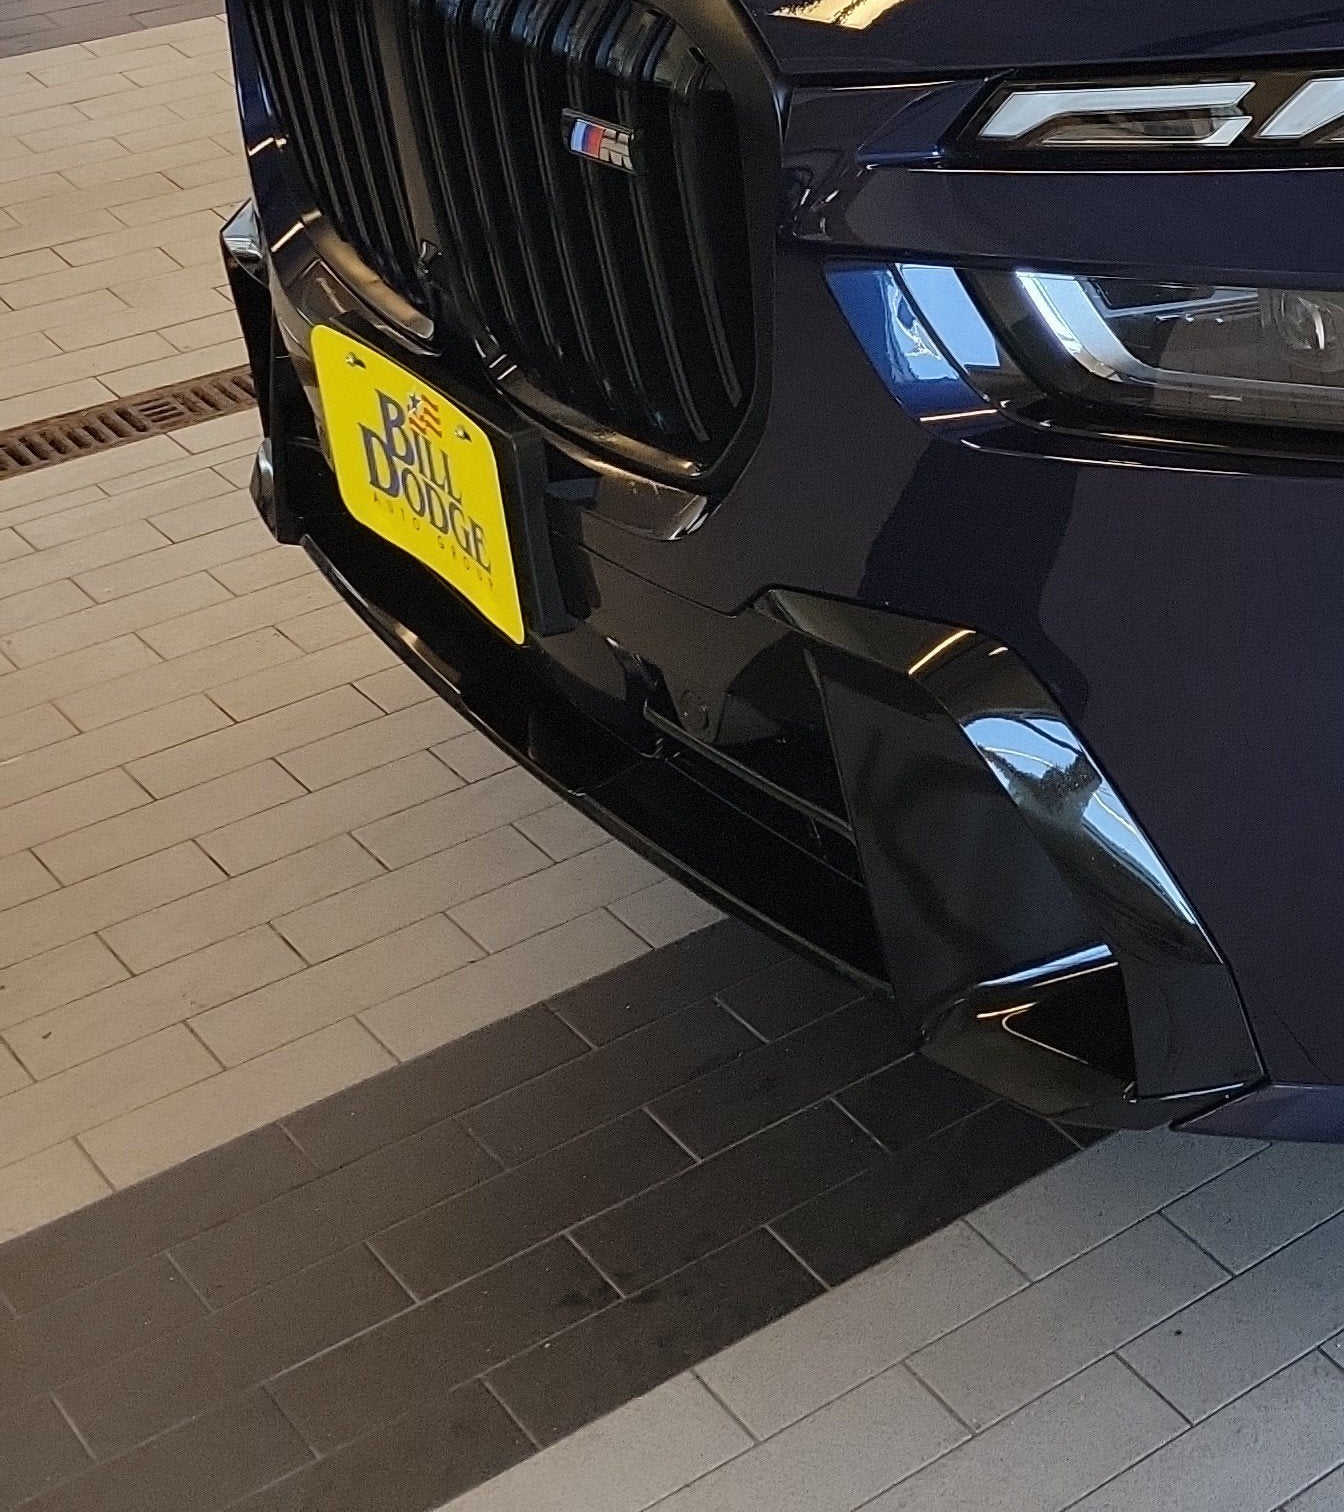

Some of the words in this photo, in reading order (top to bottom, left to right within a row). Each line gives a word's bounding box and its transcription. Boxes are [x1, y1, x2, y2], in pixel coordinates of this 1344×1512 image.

[358, 422, 492, 574] DODGE
[374, 388, 463, 505] BILL
[373, 493, 421, 531] AUTO
